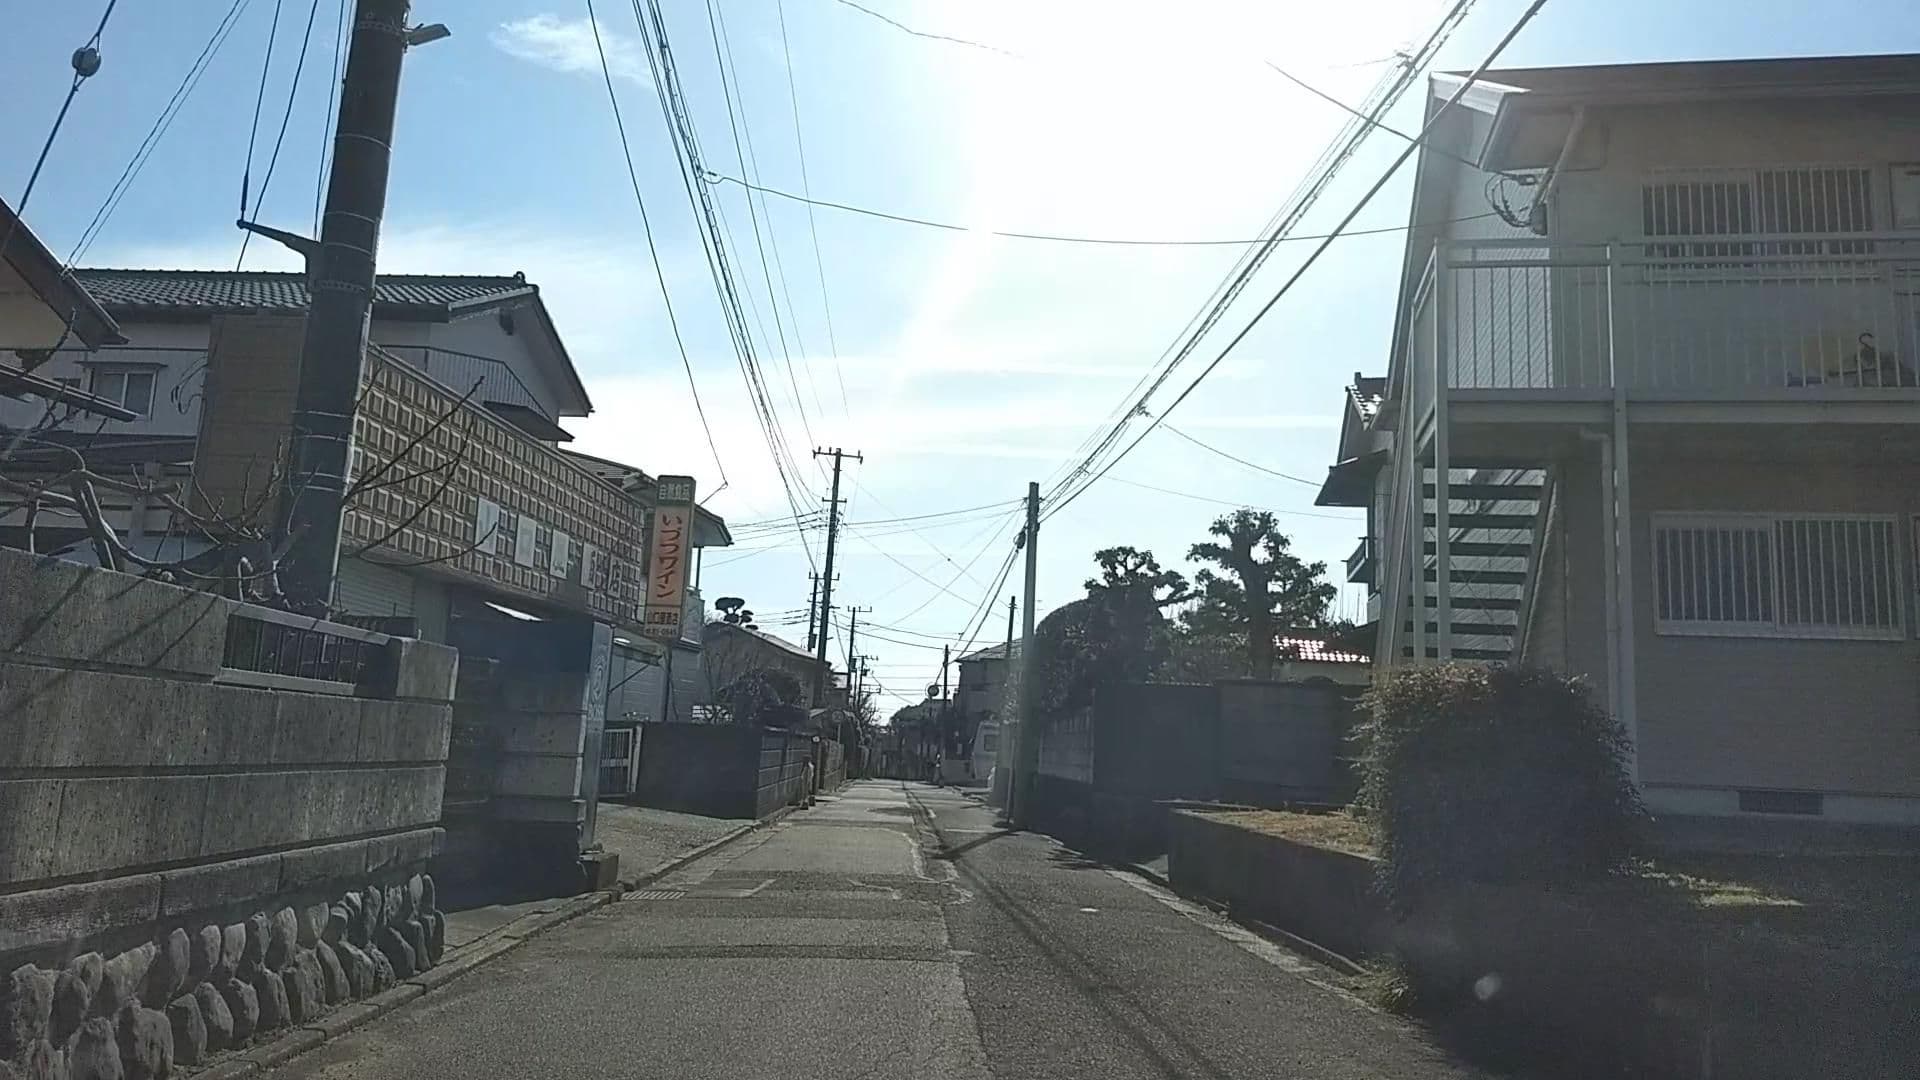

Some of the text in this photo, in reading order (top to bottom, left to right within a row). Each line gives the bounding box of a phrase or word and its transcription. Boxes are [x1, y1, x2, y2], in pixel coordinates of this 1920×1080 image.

[656, 513, 683, 598] いづつワイン
